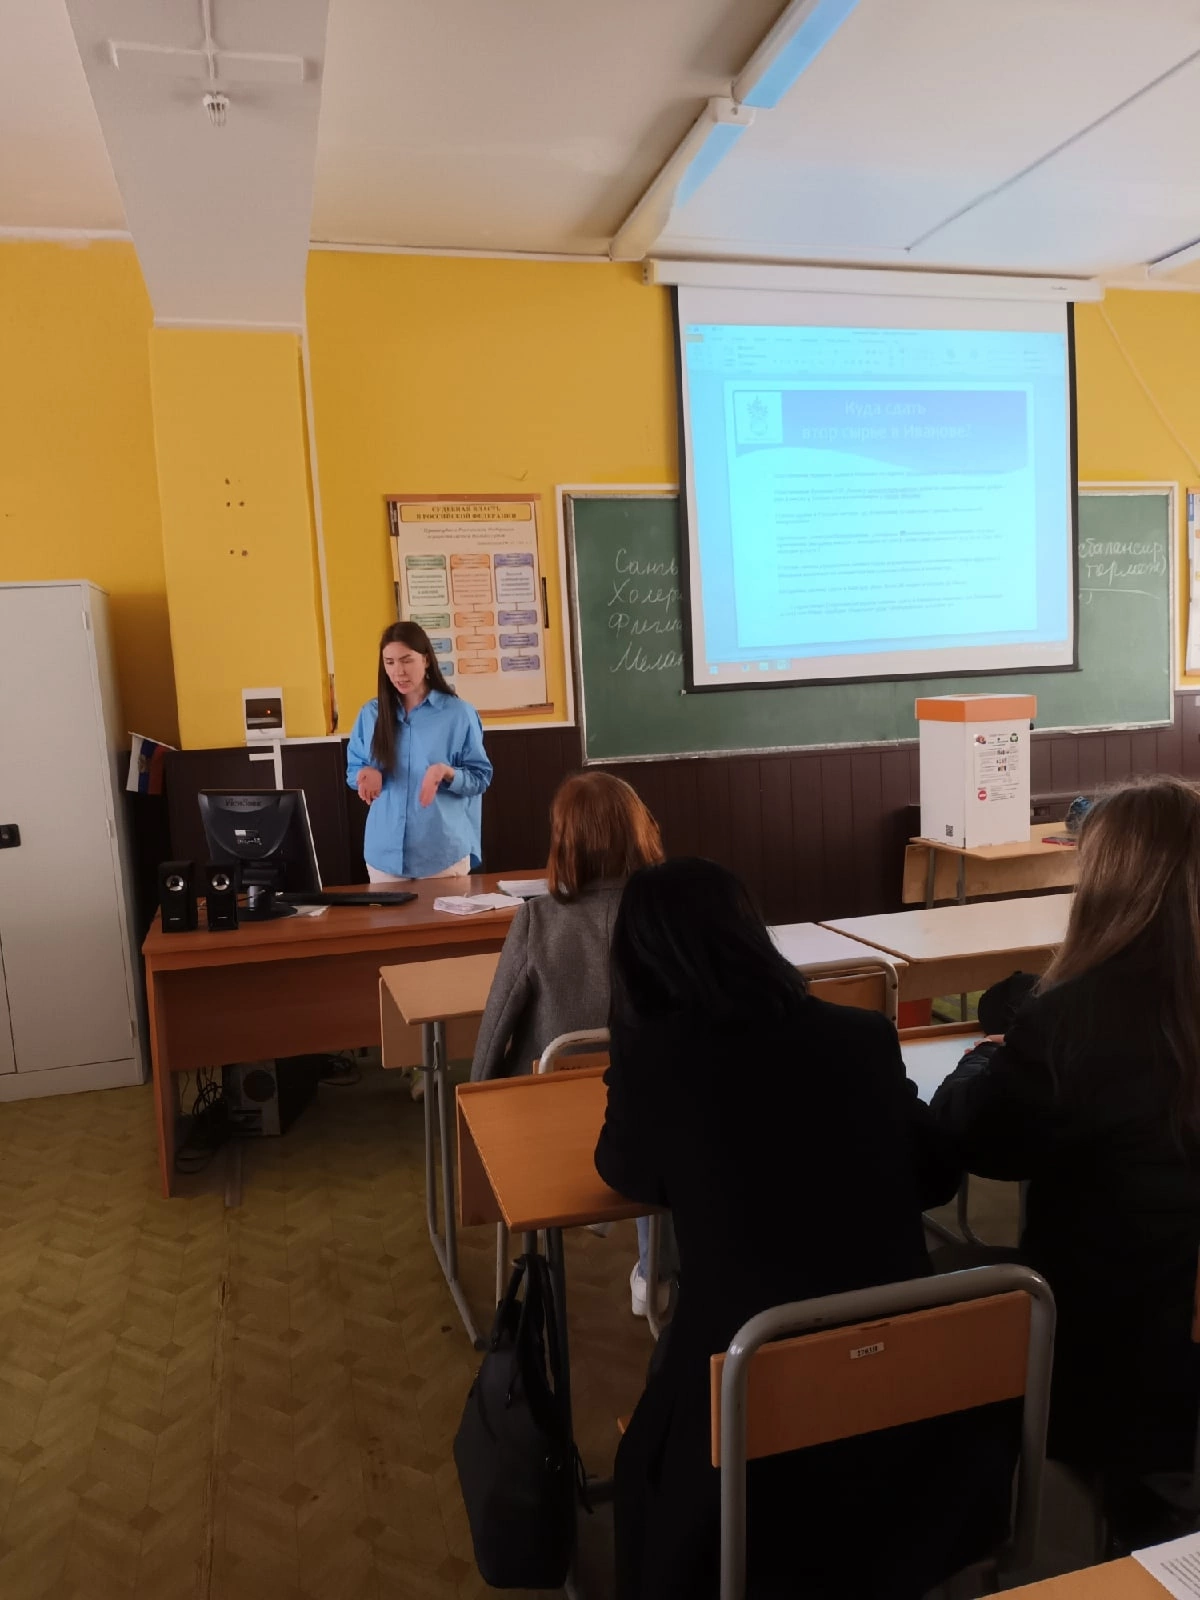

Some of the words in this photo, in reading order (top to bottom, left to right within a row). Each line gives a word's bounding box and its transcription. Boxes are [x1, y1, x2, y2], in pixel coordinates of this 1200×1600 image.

[844, 400, 881, 417] Куда
[885, 401, 927, 416] сдать
[422, 512, 471, 520] РОССИЙСКОЙ
